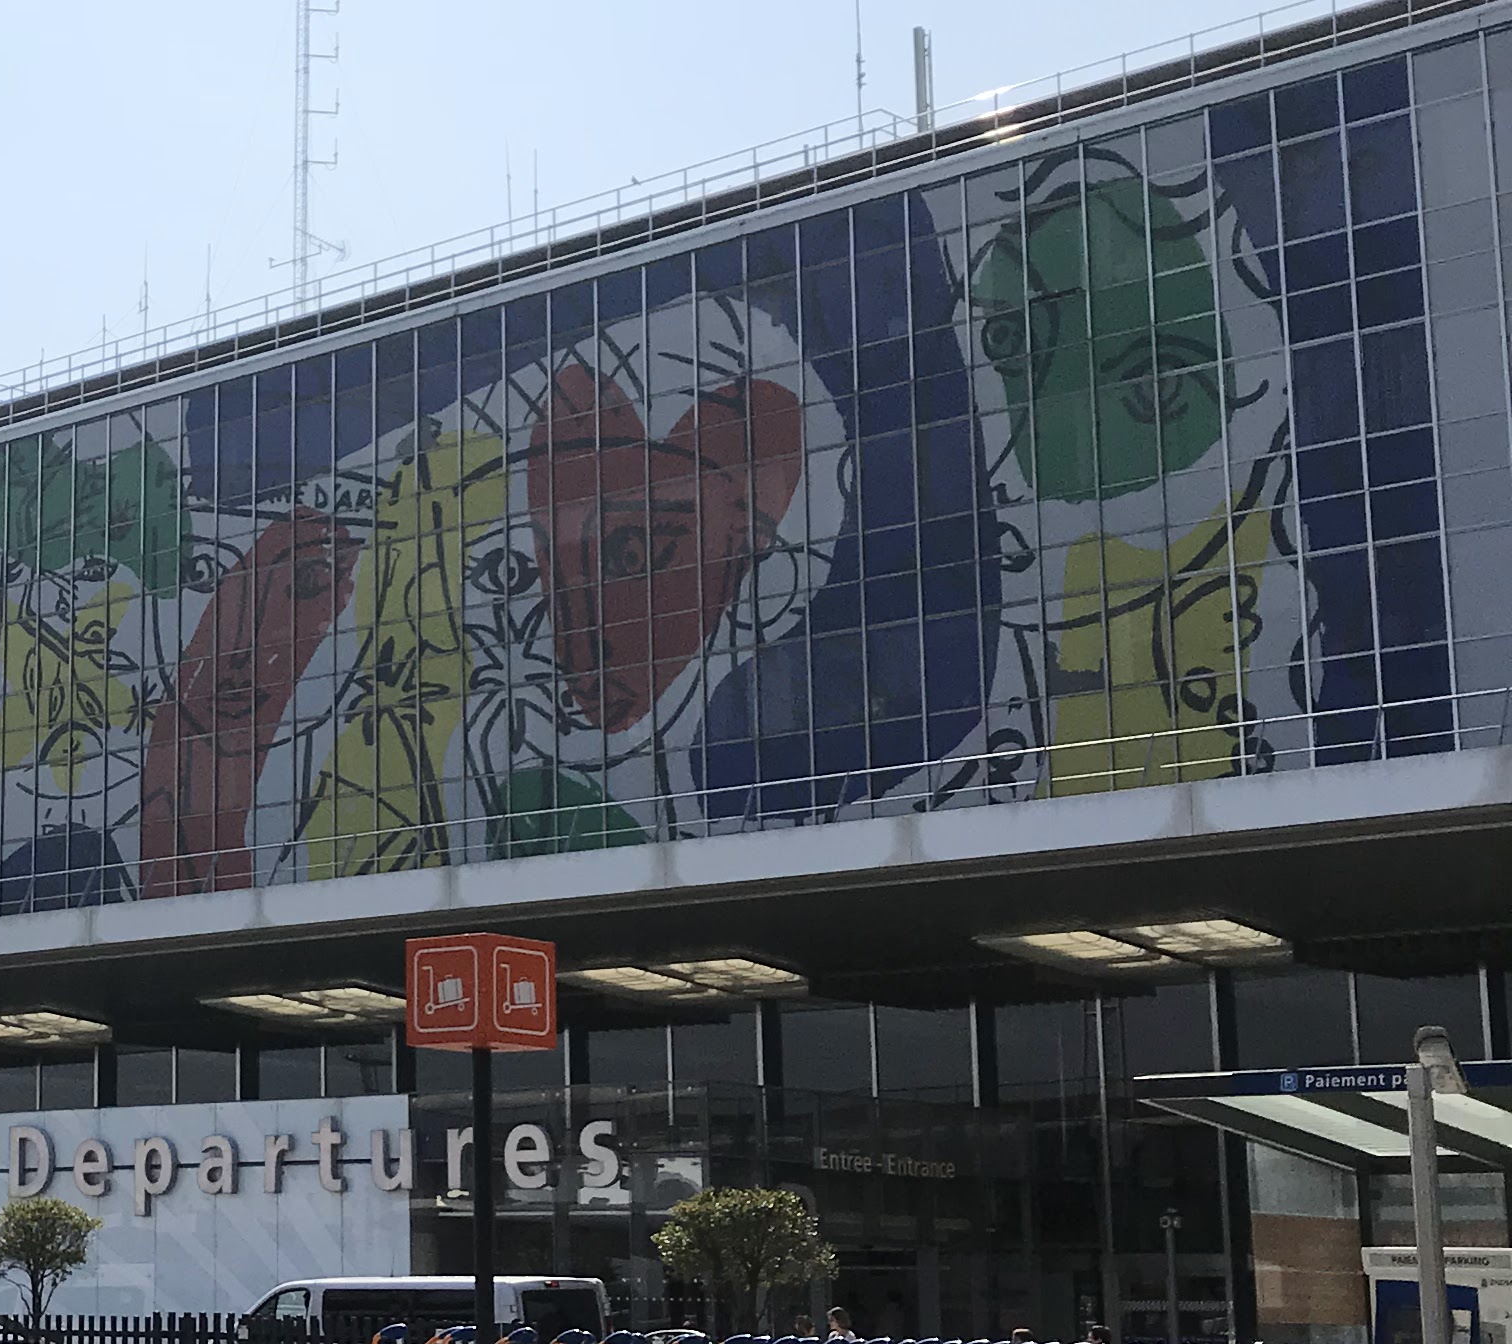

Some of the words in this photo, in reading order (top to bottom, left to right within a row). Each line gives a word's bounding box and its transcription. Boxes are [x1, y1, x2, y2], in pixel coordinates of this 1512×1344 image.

[1304, 1072, 1386, 1088] Paiement
[8, 1114, 623, 1217] Departures
[887, 1153, 956, 1179] Entrance
